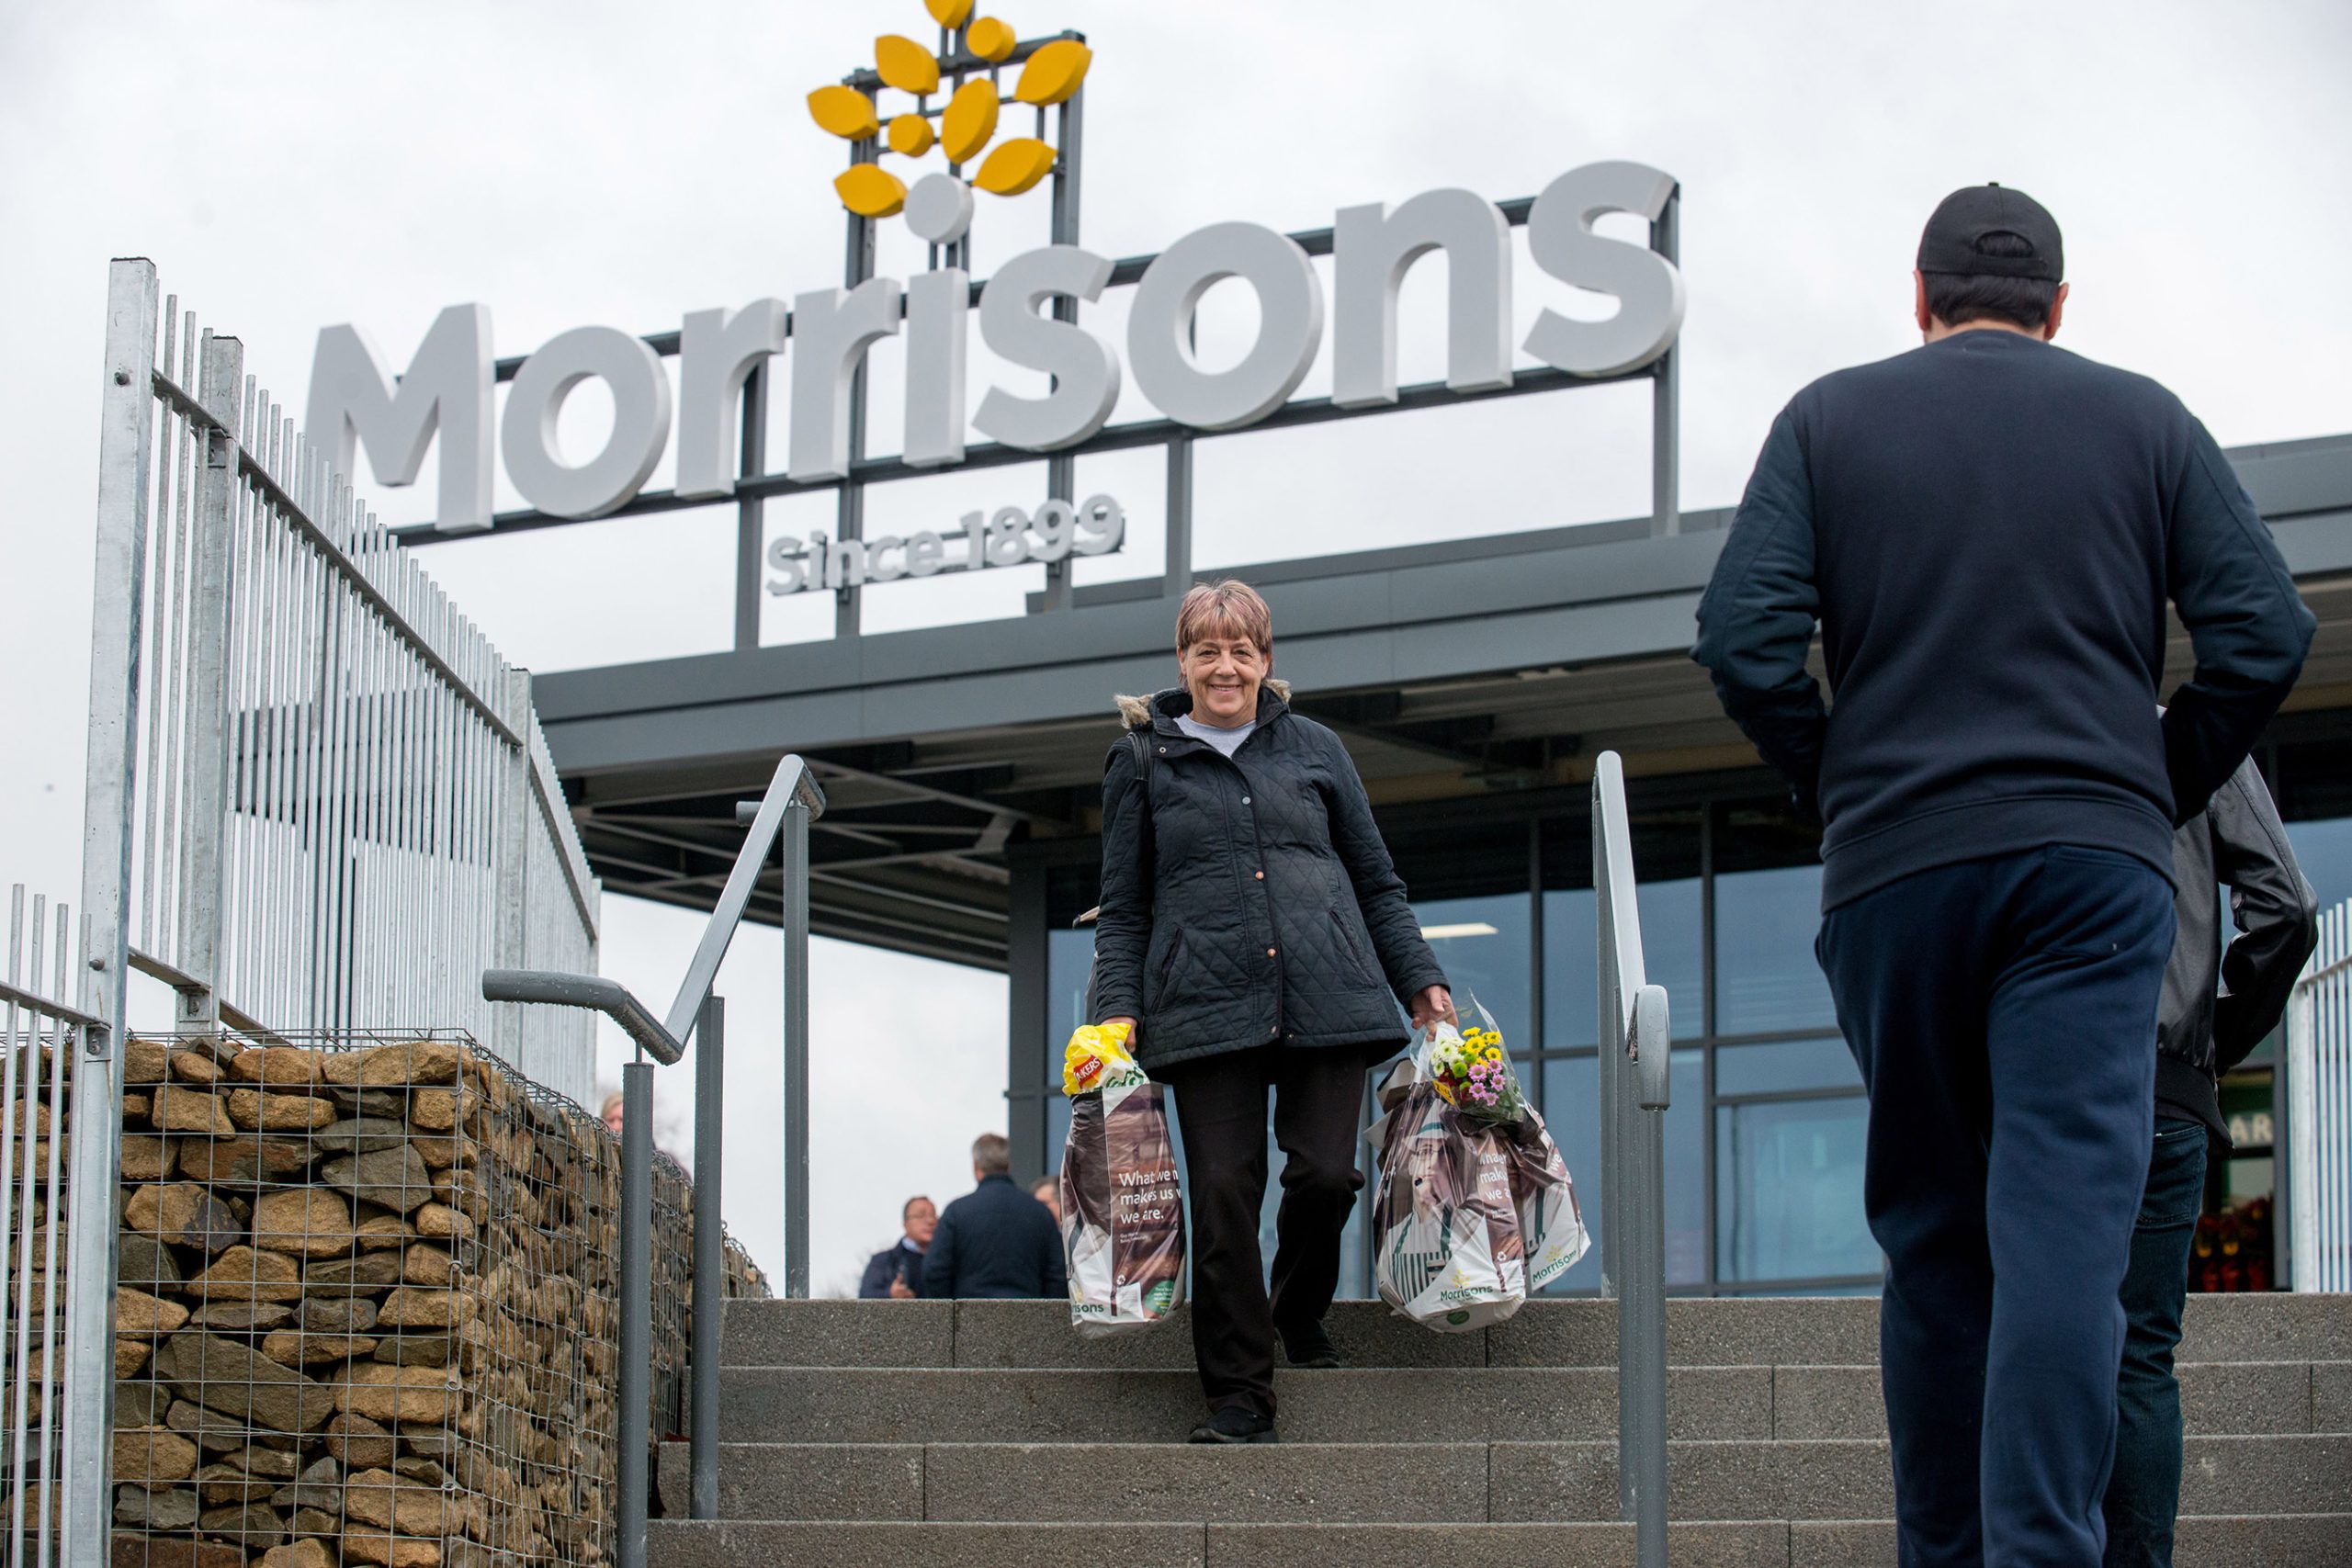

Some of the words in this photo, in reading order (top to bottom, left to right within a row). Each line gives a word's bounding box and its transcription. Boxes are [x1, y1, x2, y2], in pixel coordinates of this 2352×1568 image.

[305, 160, 1685, 533] Morrisons
[766, 529, 944, 595] Since
[960, 493, 1125, 570] 1899
[1073, 1056, 1102, 1082] AKERS
[1118, 1170, 1155, 1188] What
[1479, 1167, 1509, 1184] mak
[1121, 1189, 1158, 1206] makes
[1159, 1189, 1173, 1200] us
[1485, 1189, 1502, 1201] we
[1121, 1212, 1139, 1224] we
[1142, 1208, 1164, 1221] are.
[1440, 1284, 1493, 1301] Morrisons
